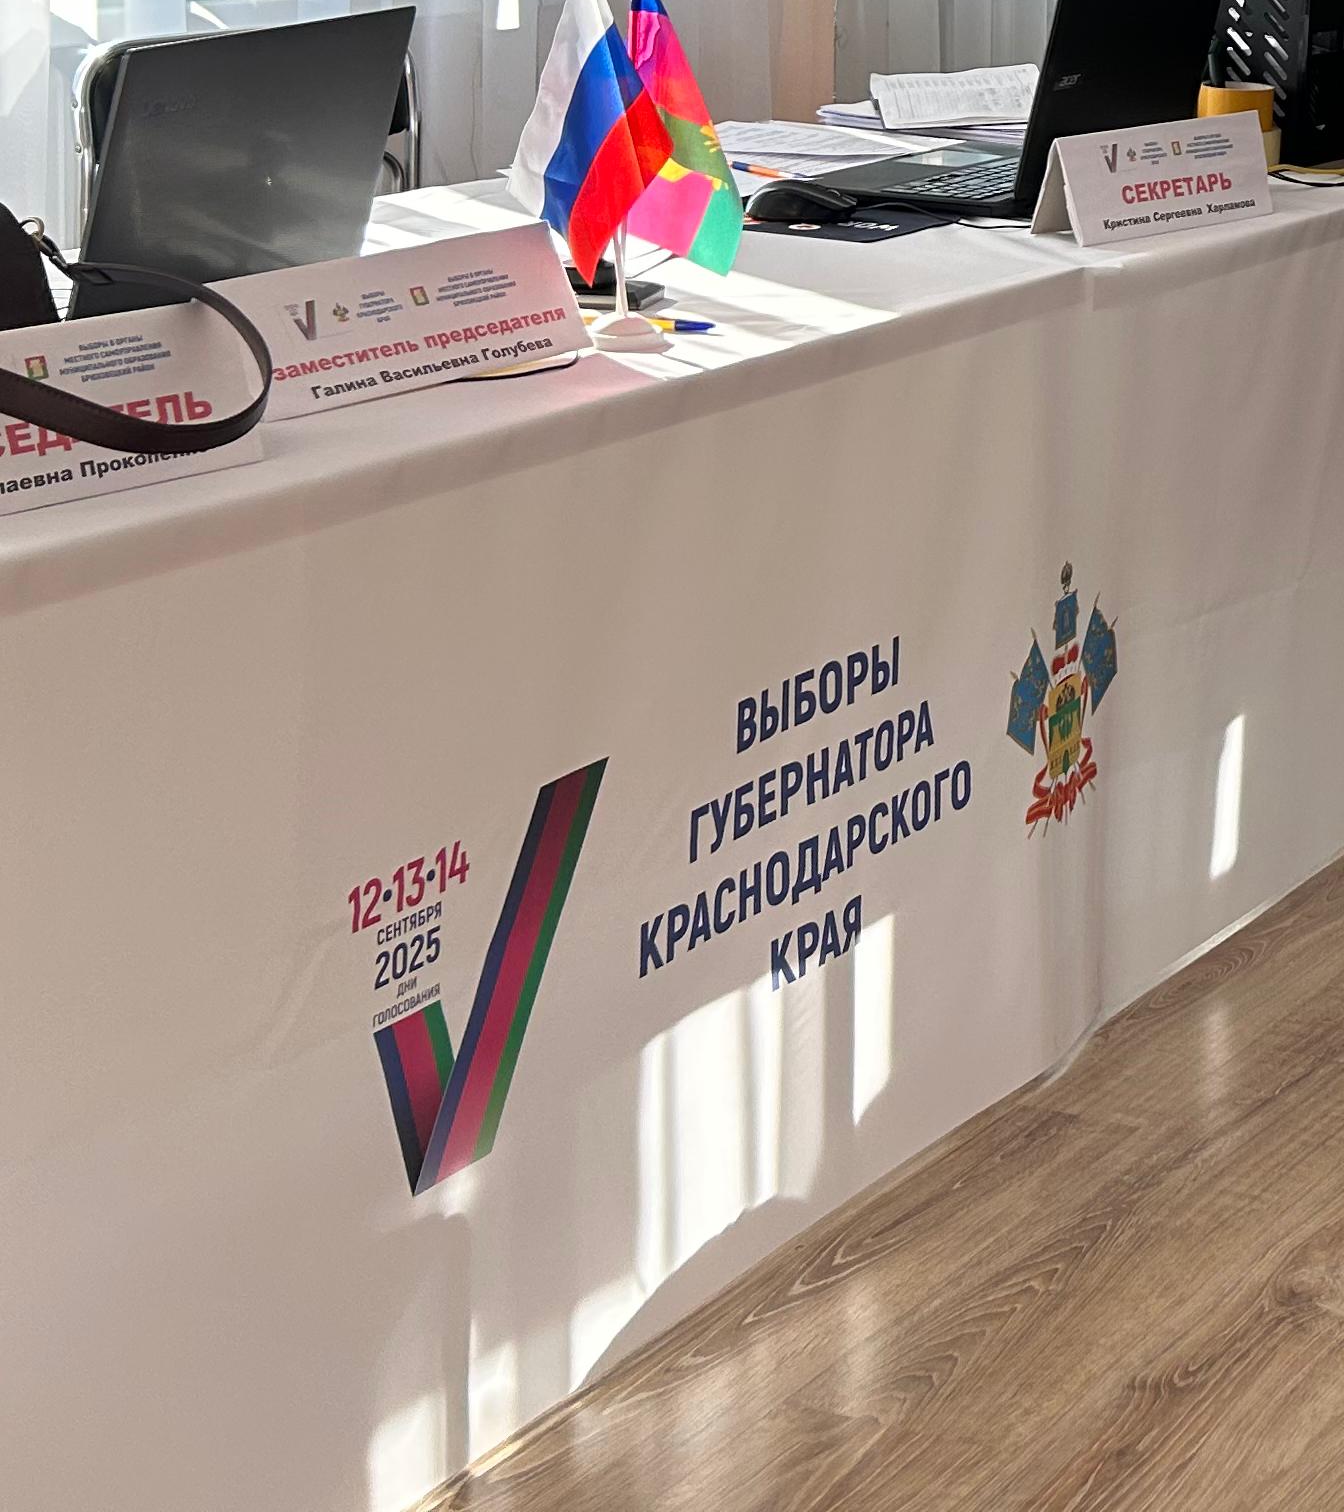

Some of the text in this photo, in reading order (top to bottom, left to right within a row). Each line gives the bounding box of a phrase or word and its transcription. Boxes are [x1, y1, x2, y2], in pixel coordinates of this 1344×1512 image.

[1122, 172, 1232, 204] СЕКРЕТАРЬ
[272, 307, 566, 382] заместитель председателя
[311, 336, 552, 400] Галина Васильевна Голубева
[736, 636, 900, 754] ВЫБОРЫ
[688, 700, 934, 863] ГУБЕРНАТОРА
[638, 760, 972, 978] КРАСНОДАРСКОГО
[377, 901, 442, 946] СЕНТЯБРЯ
[770, 896, 863, 991] КРАЯ
[374, 925, 441, 990] 2025
[396, 976, 417, 999] ДНИ
[372, 983, 440, 1028] ГОЛОСОВАНИЯ
